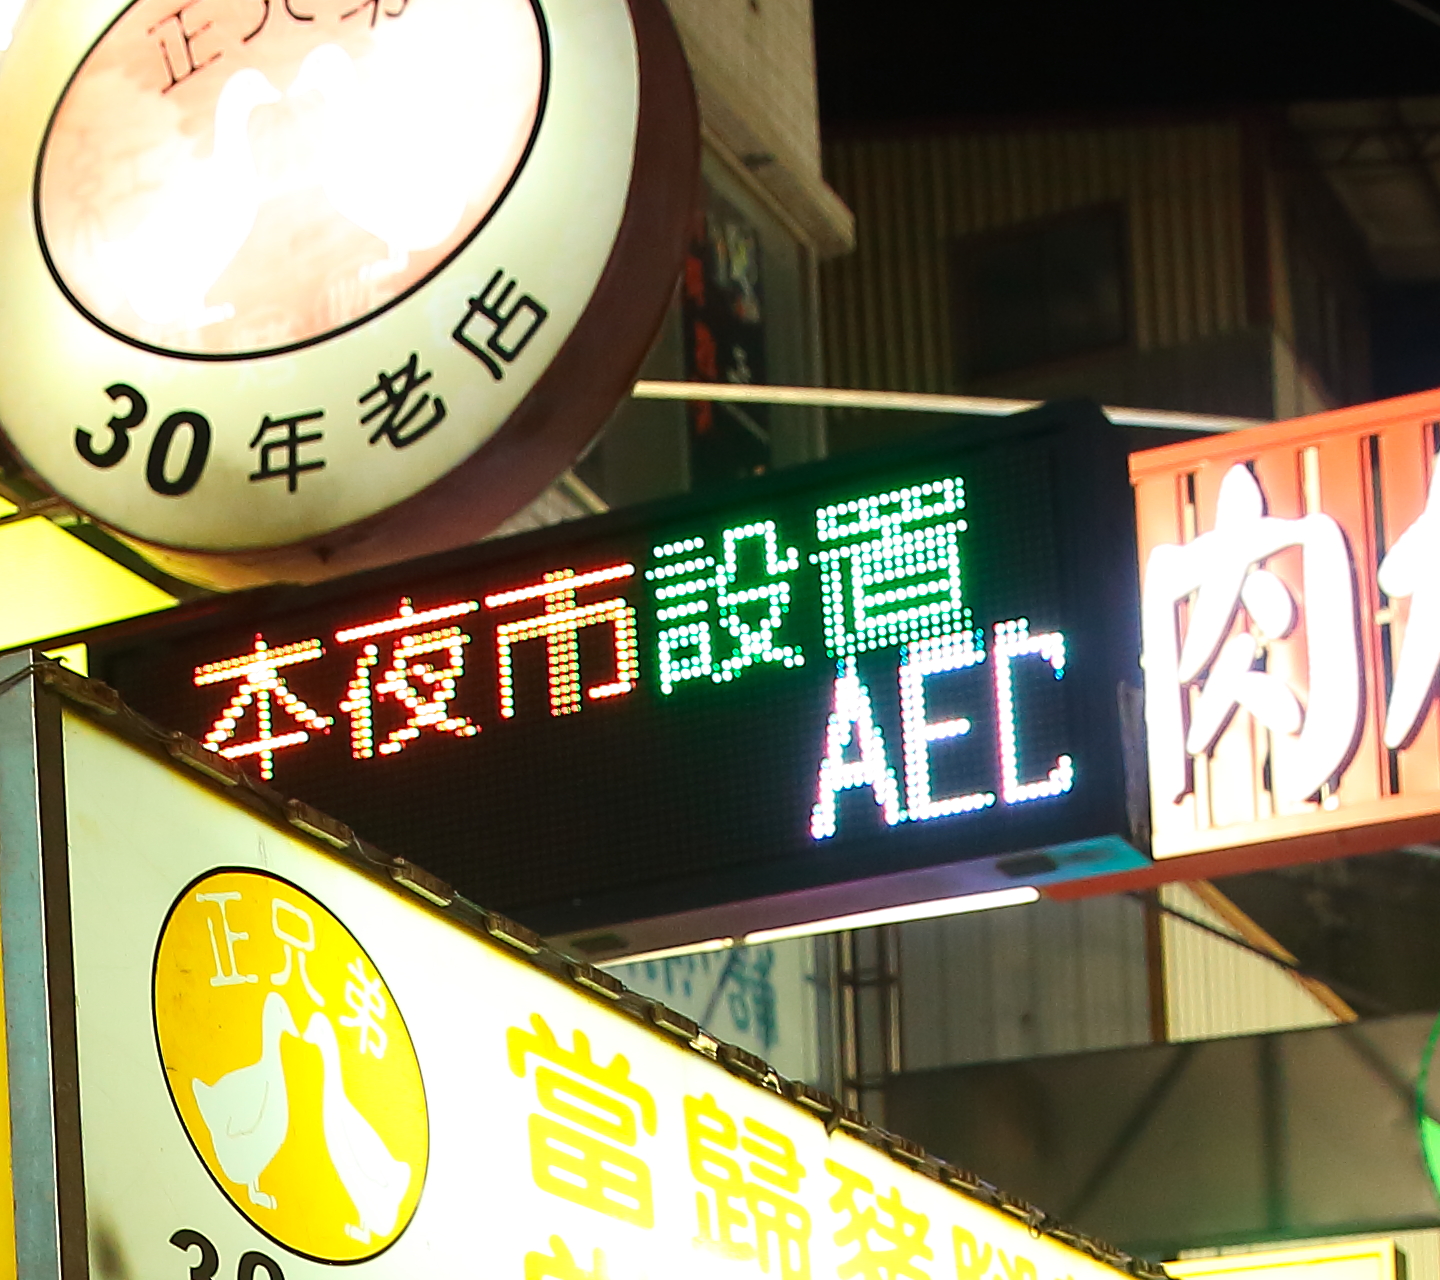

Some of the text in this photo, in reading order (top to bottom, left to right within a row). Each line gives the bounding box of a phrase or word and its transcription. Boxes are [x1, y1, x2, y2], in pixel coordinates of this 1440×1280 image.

[75, 268, 548, 496] 30年老店
[193, 477, 968, 780] 本夜市設置
[195, 891, 388, 1064] 正兄弟
